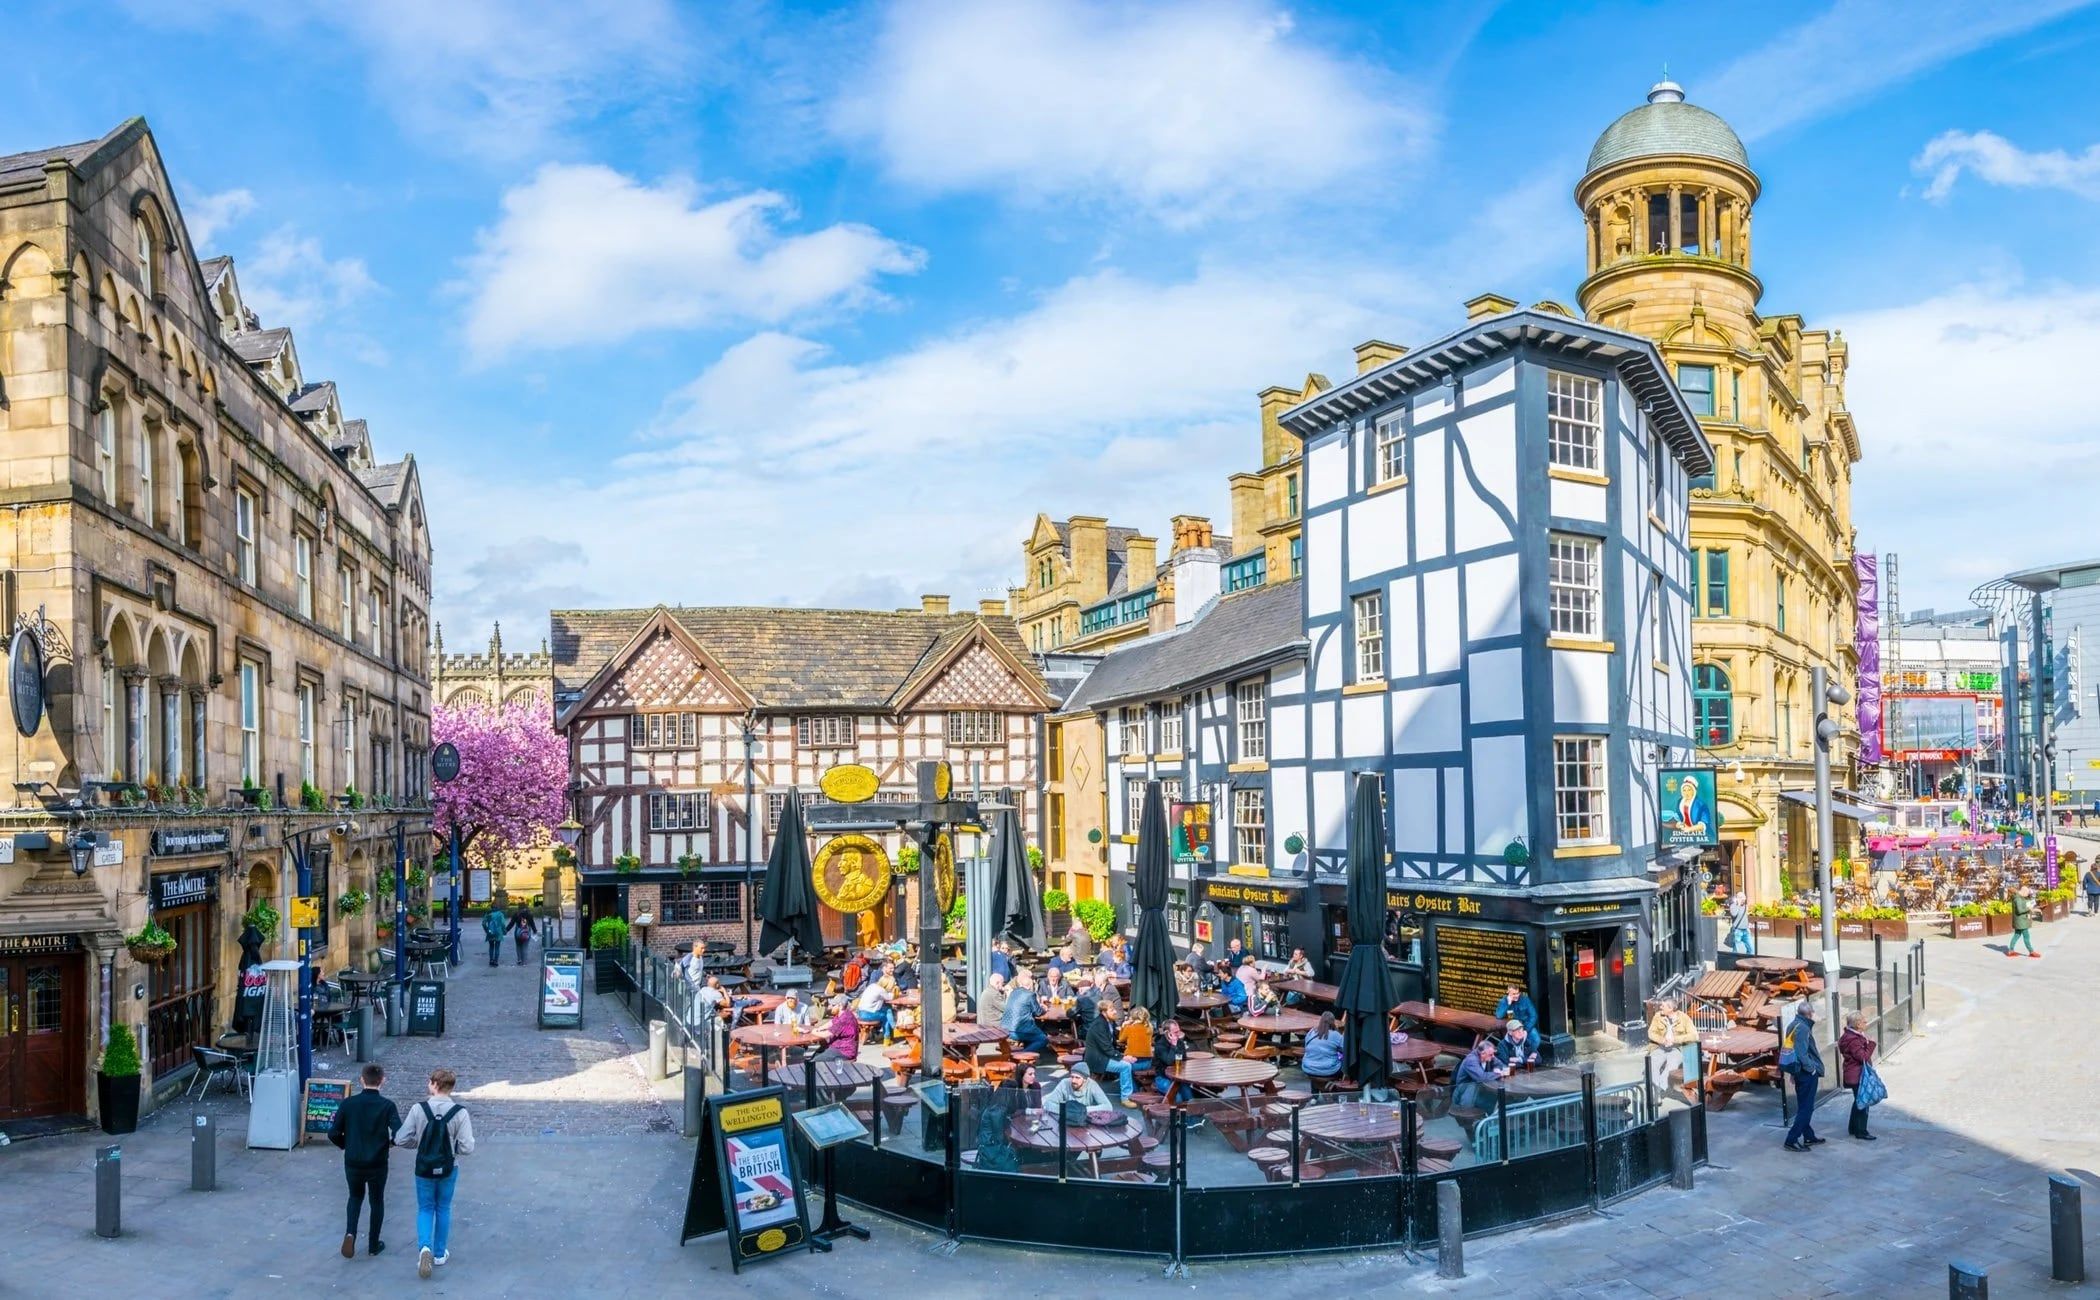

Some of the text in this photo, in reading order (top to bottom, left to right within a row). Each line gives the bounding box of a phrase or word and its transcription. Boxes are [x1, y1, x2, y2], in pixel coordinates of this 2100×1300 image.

[161, 877, 206, 896] THE MITRE
[1243, 887, 1269, 903] Oyster
[1271, 889, 1289, 904] Bar
[1386, 892, 1481, 914] lairs Oyster Bar
[1569, 905, 1602, 914] CATHEDRAL
[1603, 903, 1620, 911] GATES
[32, 936, 68, 947] MITRE
[725, 1110, 779, 1127] WELLINGTON
[736, 1104, 767, 1116] THE OLD
[738, 1151, 779, 1165] THE BEST OF
[739, 1159, 781, 1178] BRITISH
